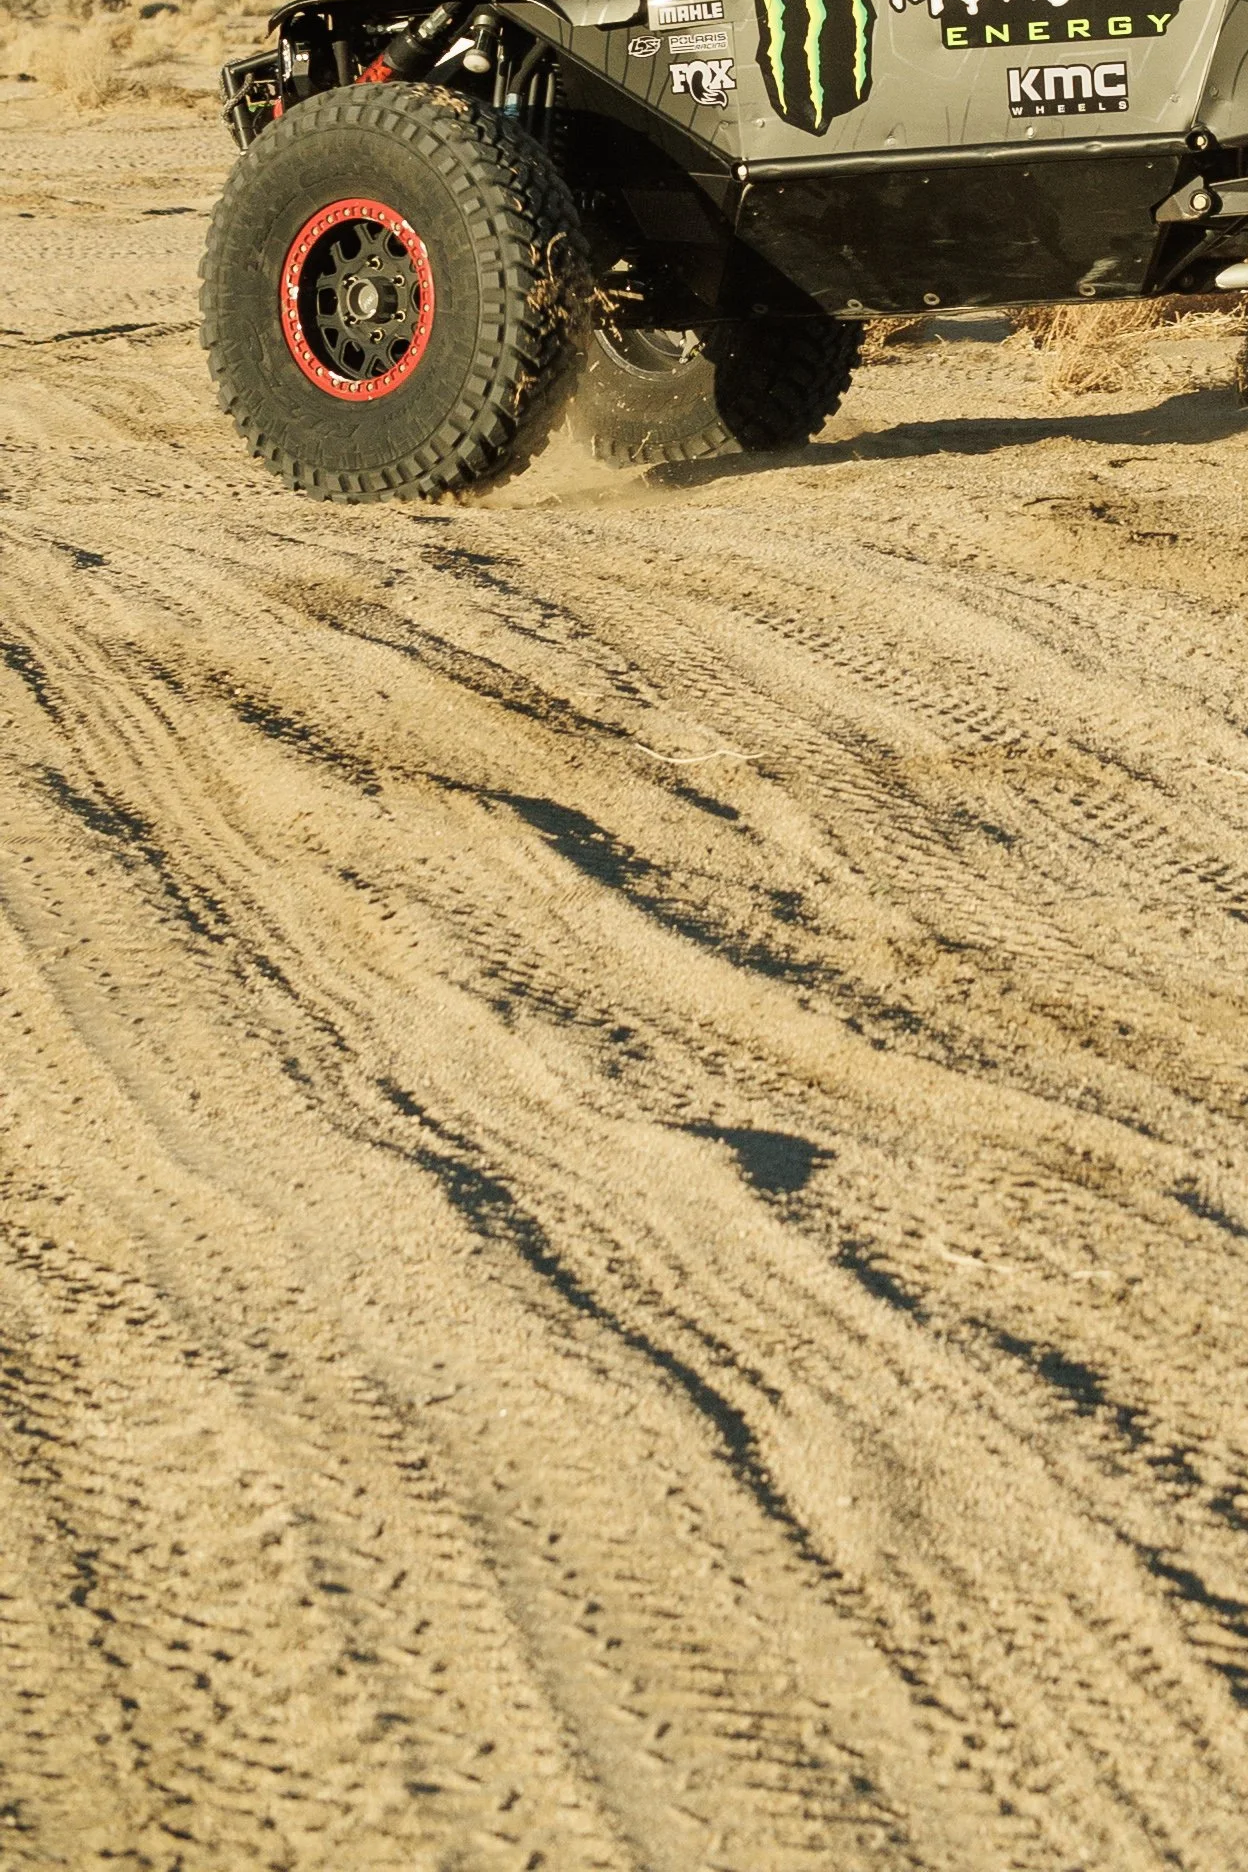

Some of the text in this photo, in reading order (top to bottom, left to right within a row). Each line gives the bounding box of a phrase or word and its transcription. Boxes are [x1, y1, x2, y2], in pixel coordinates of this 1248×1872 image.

[659, 1, 724, 24] MAHLE
[670, 32, 727, 45] POLARIS
[946, 13, 1172, 46] ENERGY
[694, 41, 727, 50] RACING
[669, 58, 736, 107] FOX
[1009, 62, 1127, 102] KMC
[1011, 100, 1128, 116] WHEELS
